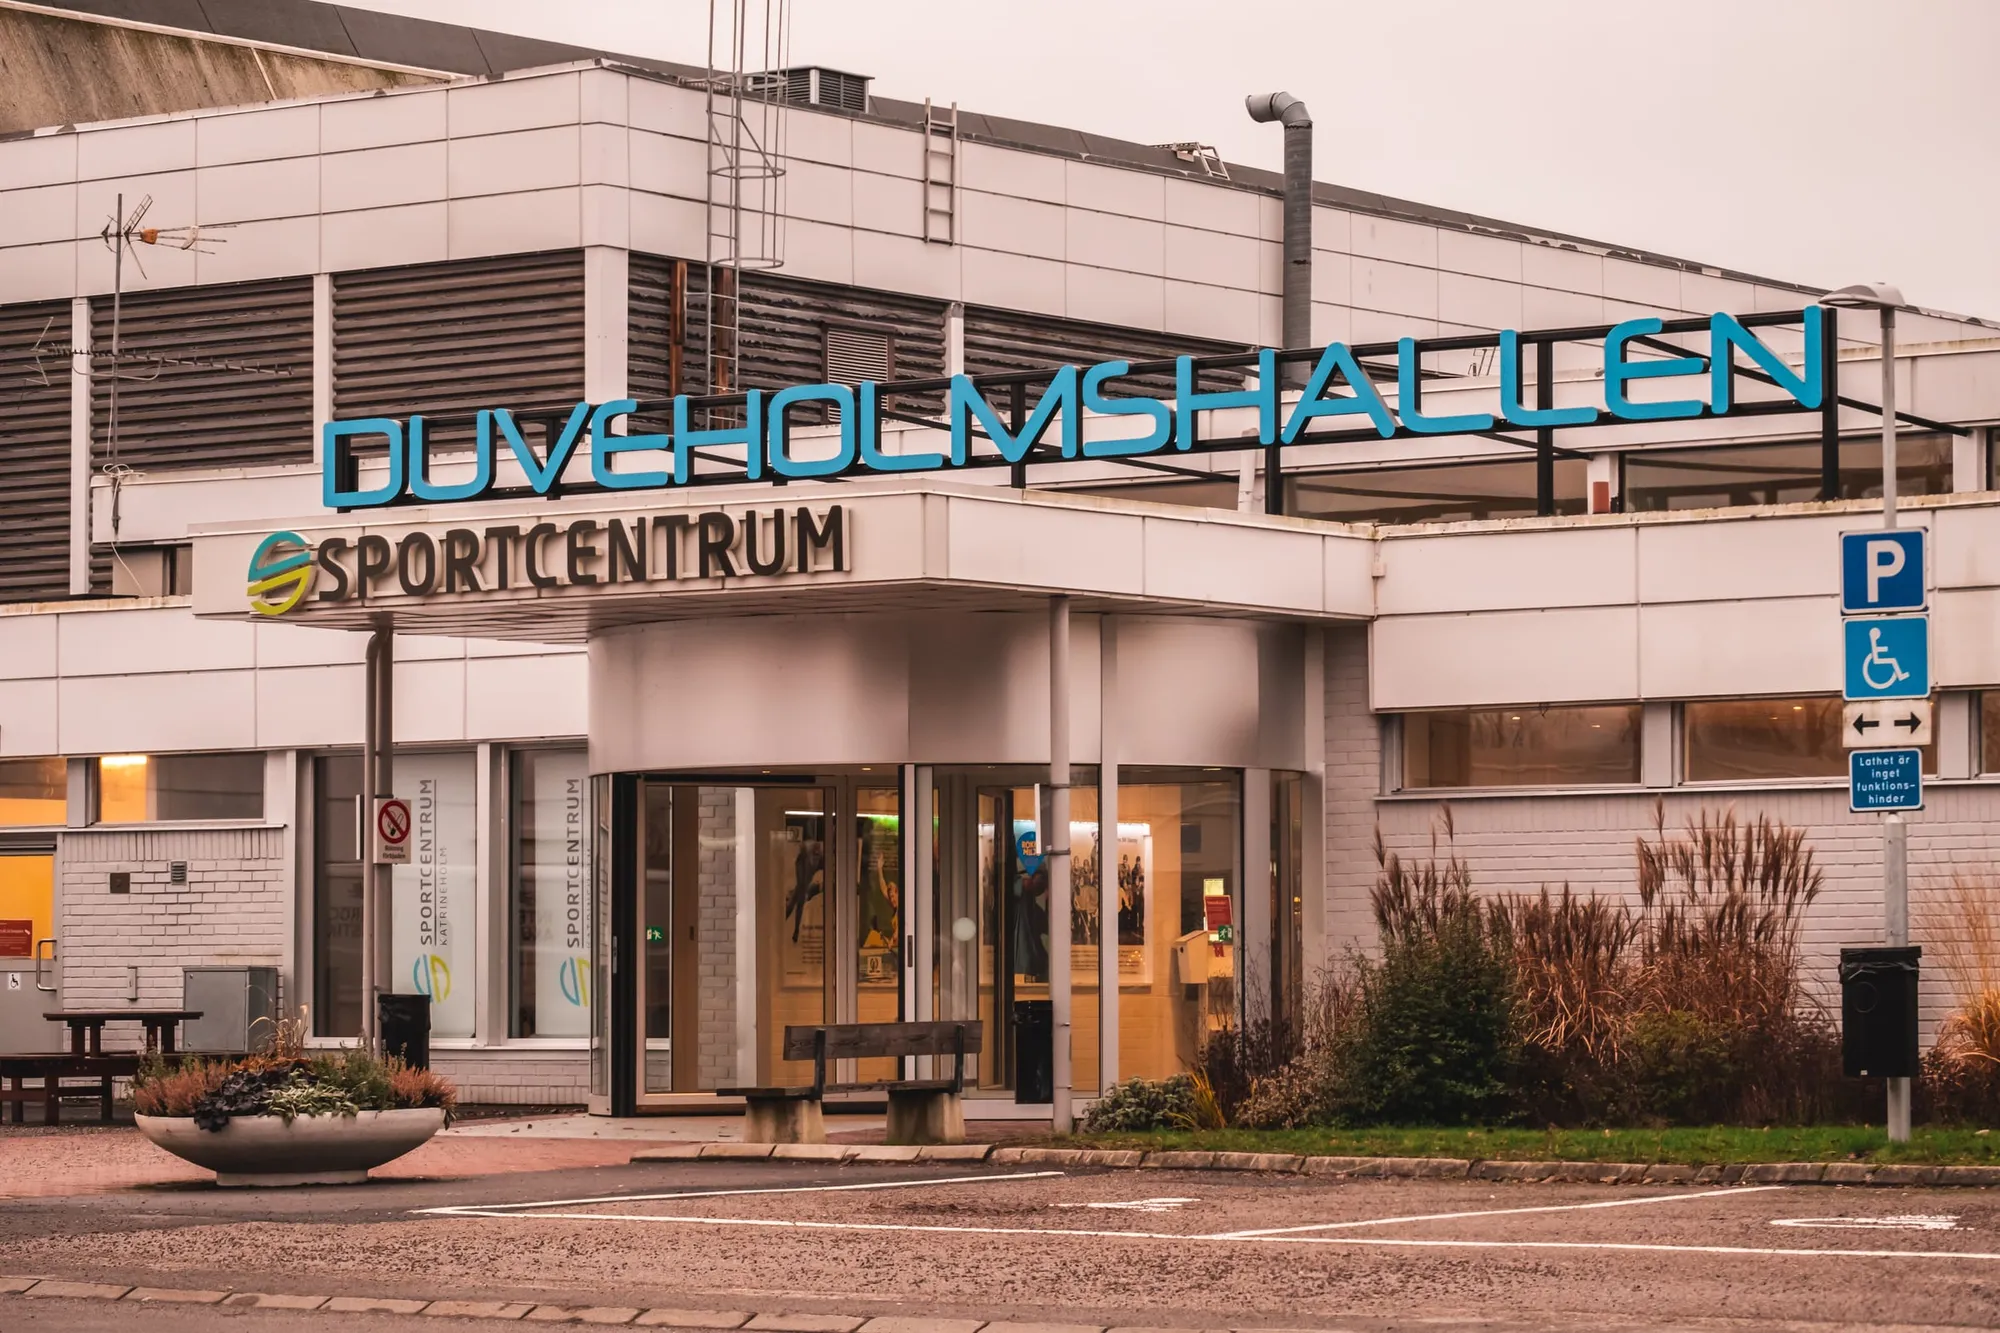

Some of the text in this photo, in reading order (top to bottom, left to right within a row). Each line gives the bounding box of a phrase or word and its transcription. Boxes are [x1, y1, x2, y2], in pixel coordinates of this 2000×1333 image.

[322, 305, 1823, 508] DUVEHOLMSHALLEN
[317, 504, 850, 601] SPORTCENTRUM
[1866, 539, 1906, 603] P
[1856, 780, 1916, 792] funktions-
[1859, 754, 1911, 767] Lathet är
[1868, 793, 1905, 804] hinder
[1871, 768, 1900, 780] inget
[420, 778, 433, 946] SPORTCENTRUM
[439, 846, 449, 946] KATRINEHOLM
[566, 778, 580, 949] SPORTCENTRUM
